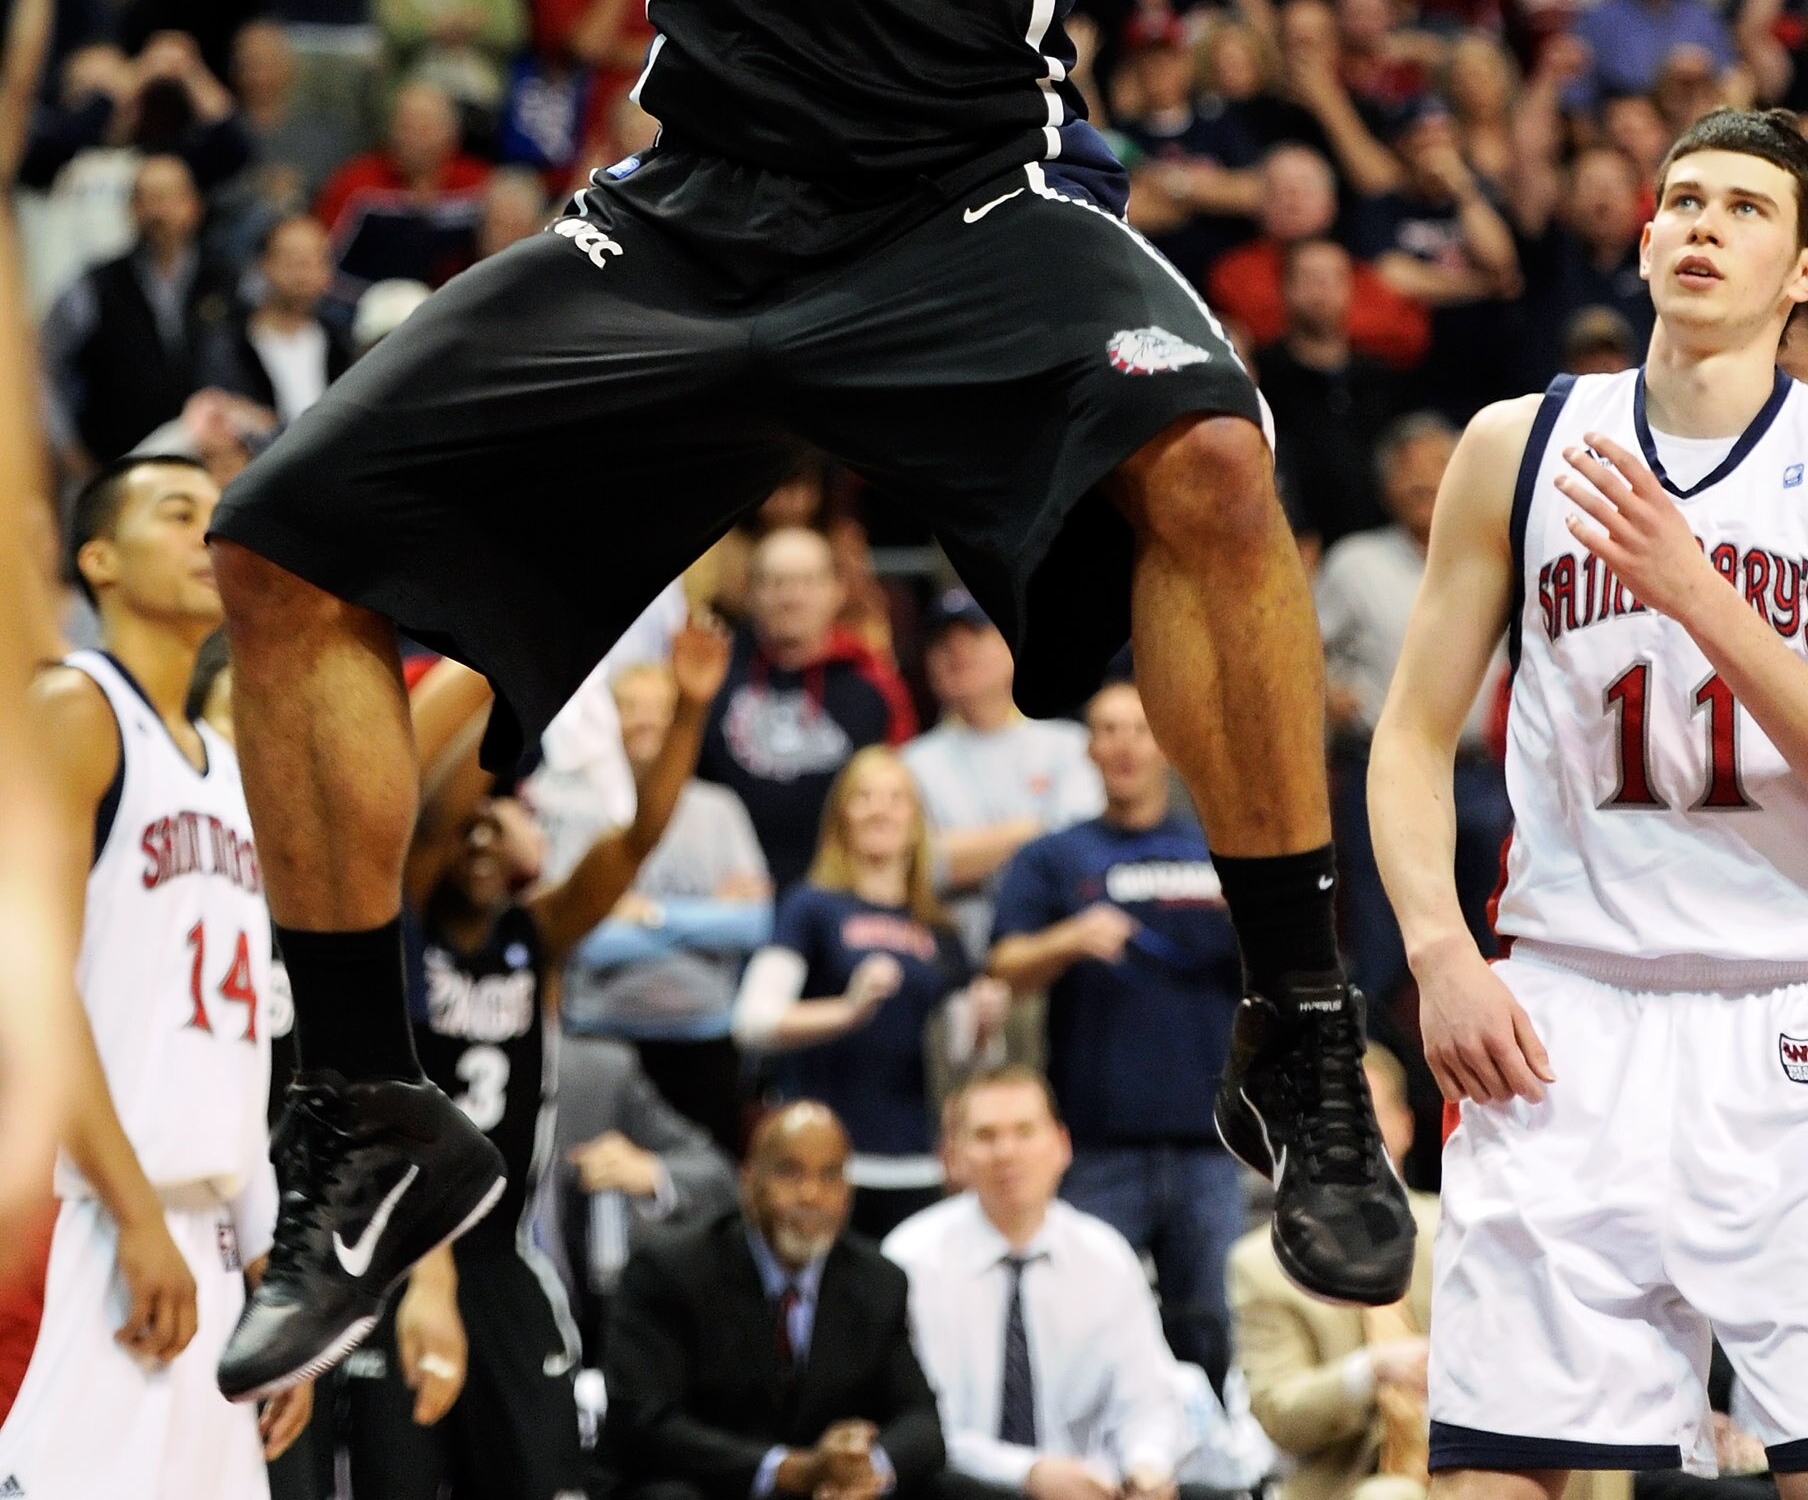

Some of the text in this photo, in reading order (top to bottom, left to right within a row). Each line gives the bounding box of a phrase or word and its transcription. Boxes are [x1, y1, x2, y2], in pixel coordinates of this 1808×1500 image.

[1596, 660, 1763, 812] 11
[182, 919, 257, 1045] 14
[454, 1044, 510, 1132] 3
